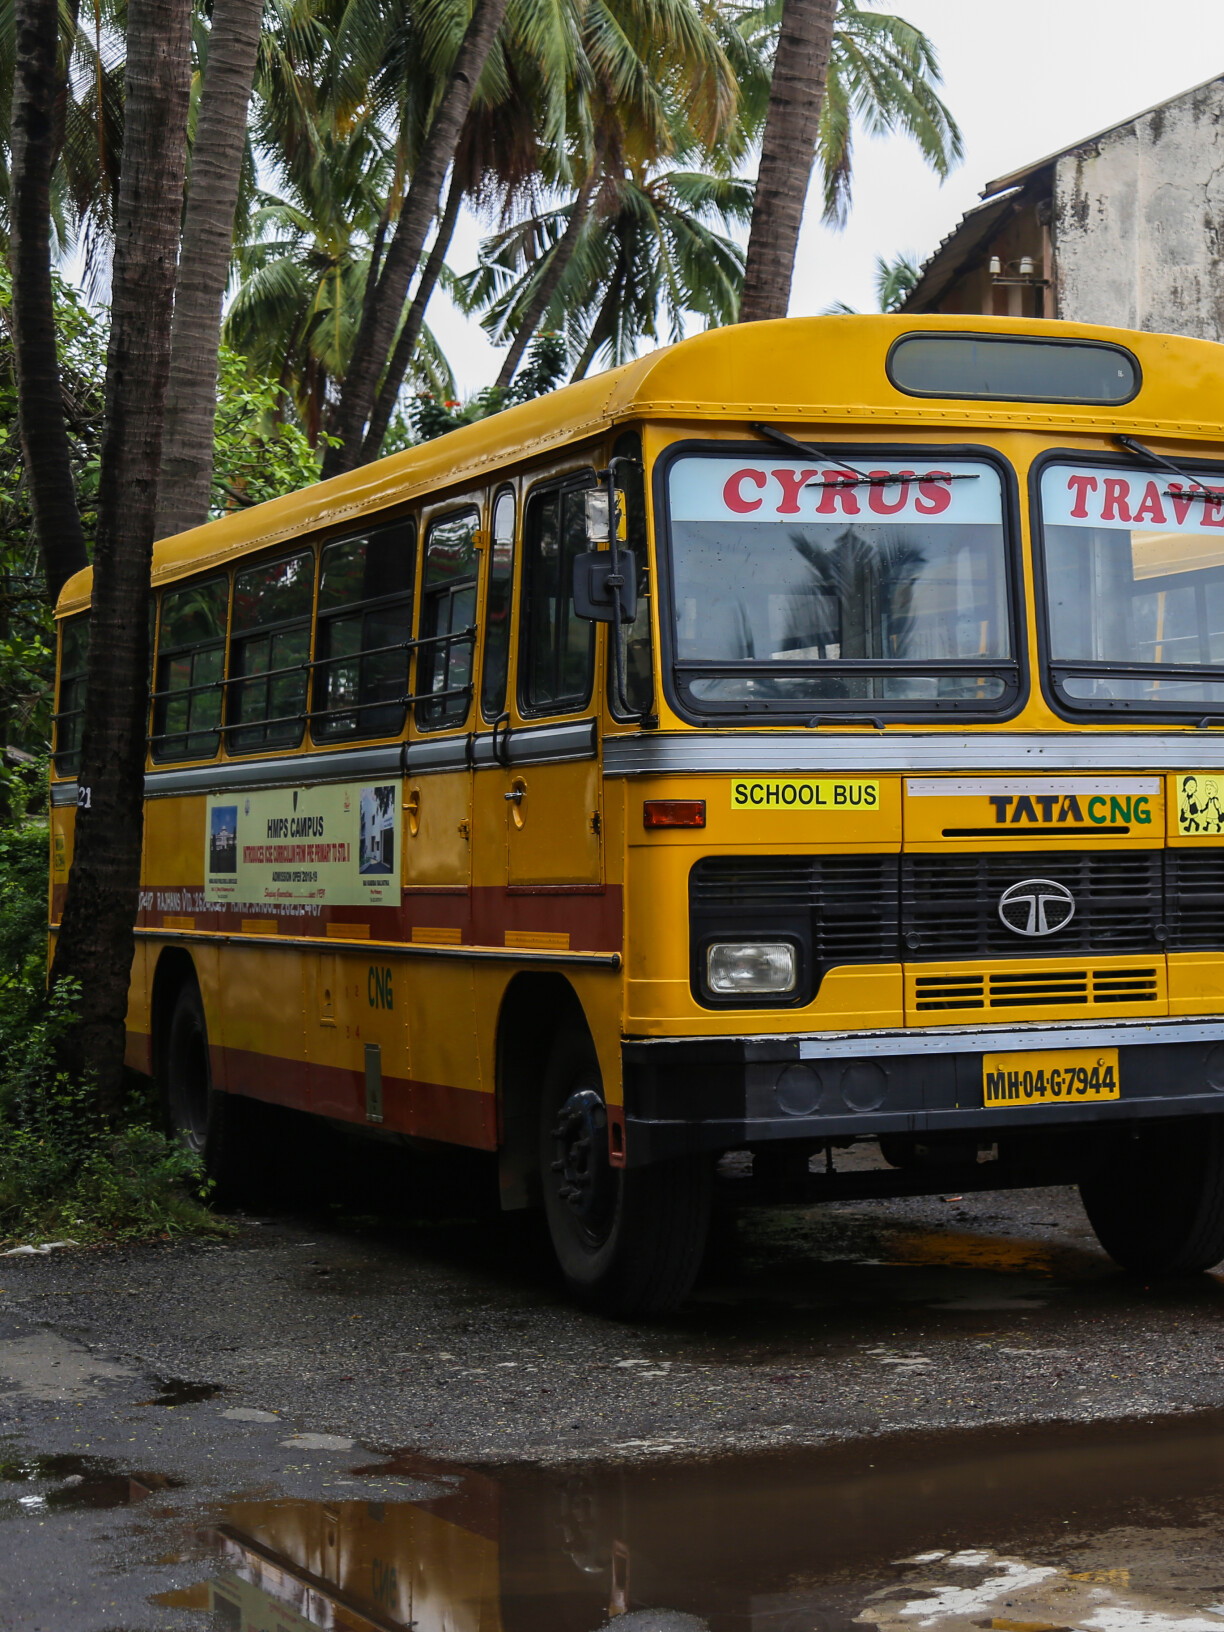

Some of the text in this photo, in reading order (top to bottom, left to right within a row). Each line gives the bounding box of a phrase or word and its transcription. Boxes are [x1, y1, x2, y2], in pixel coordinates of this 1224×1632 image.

[722, 468, 952, 514] CYRUS
[735, 784, 877, 806] SCHOOL BUS
[989, 795, 1152, 824] TATA CNG
[267, 818, 289, 838] HMPS
[368, 966, 393, 1010] CNG
